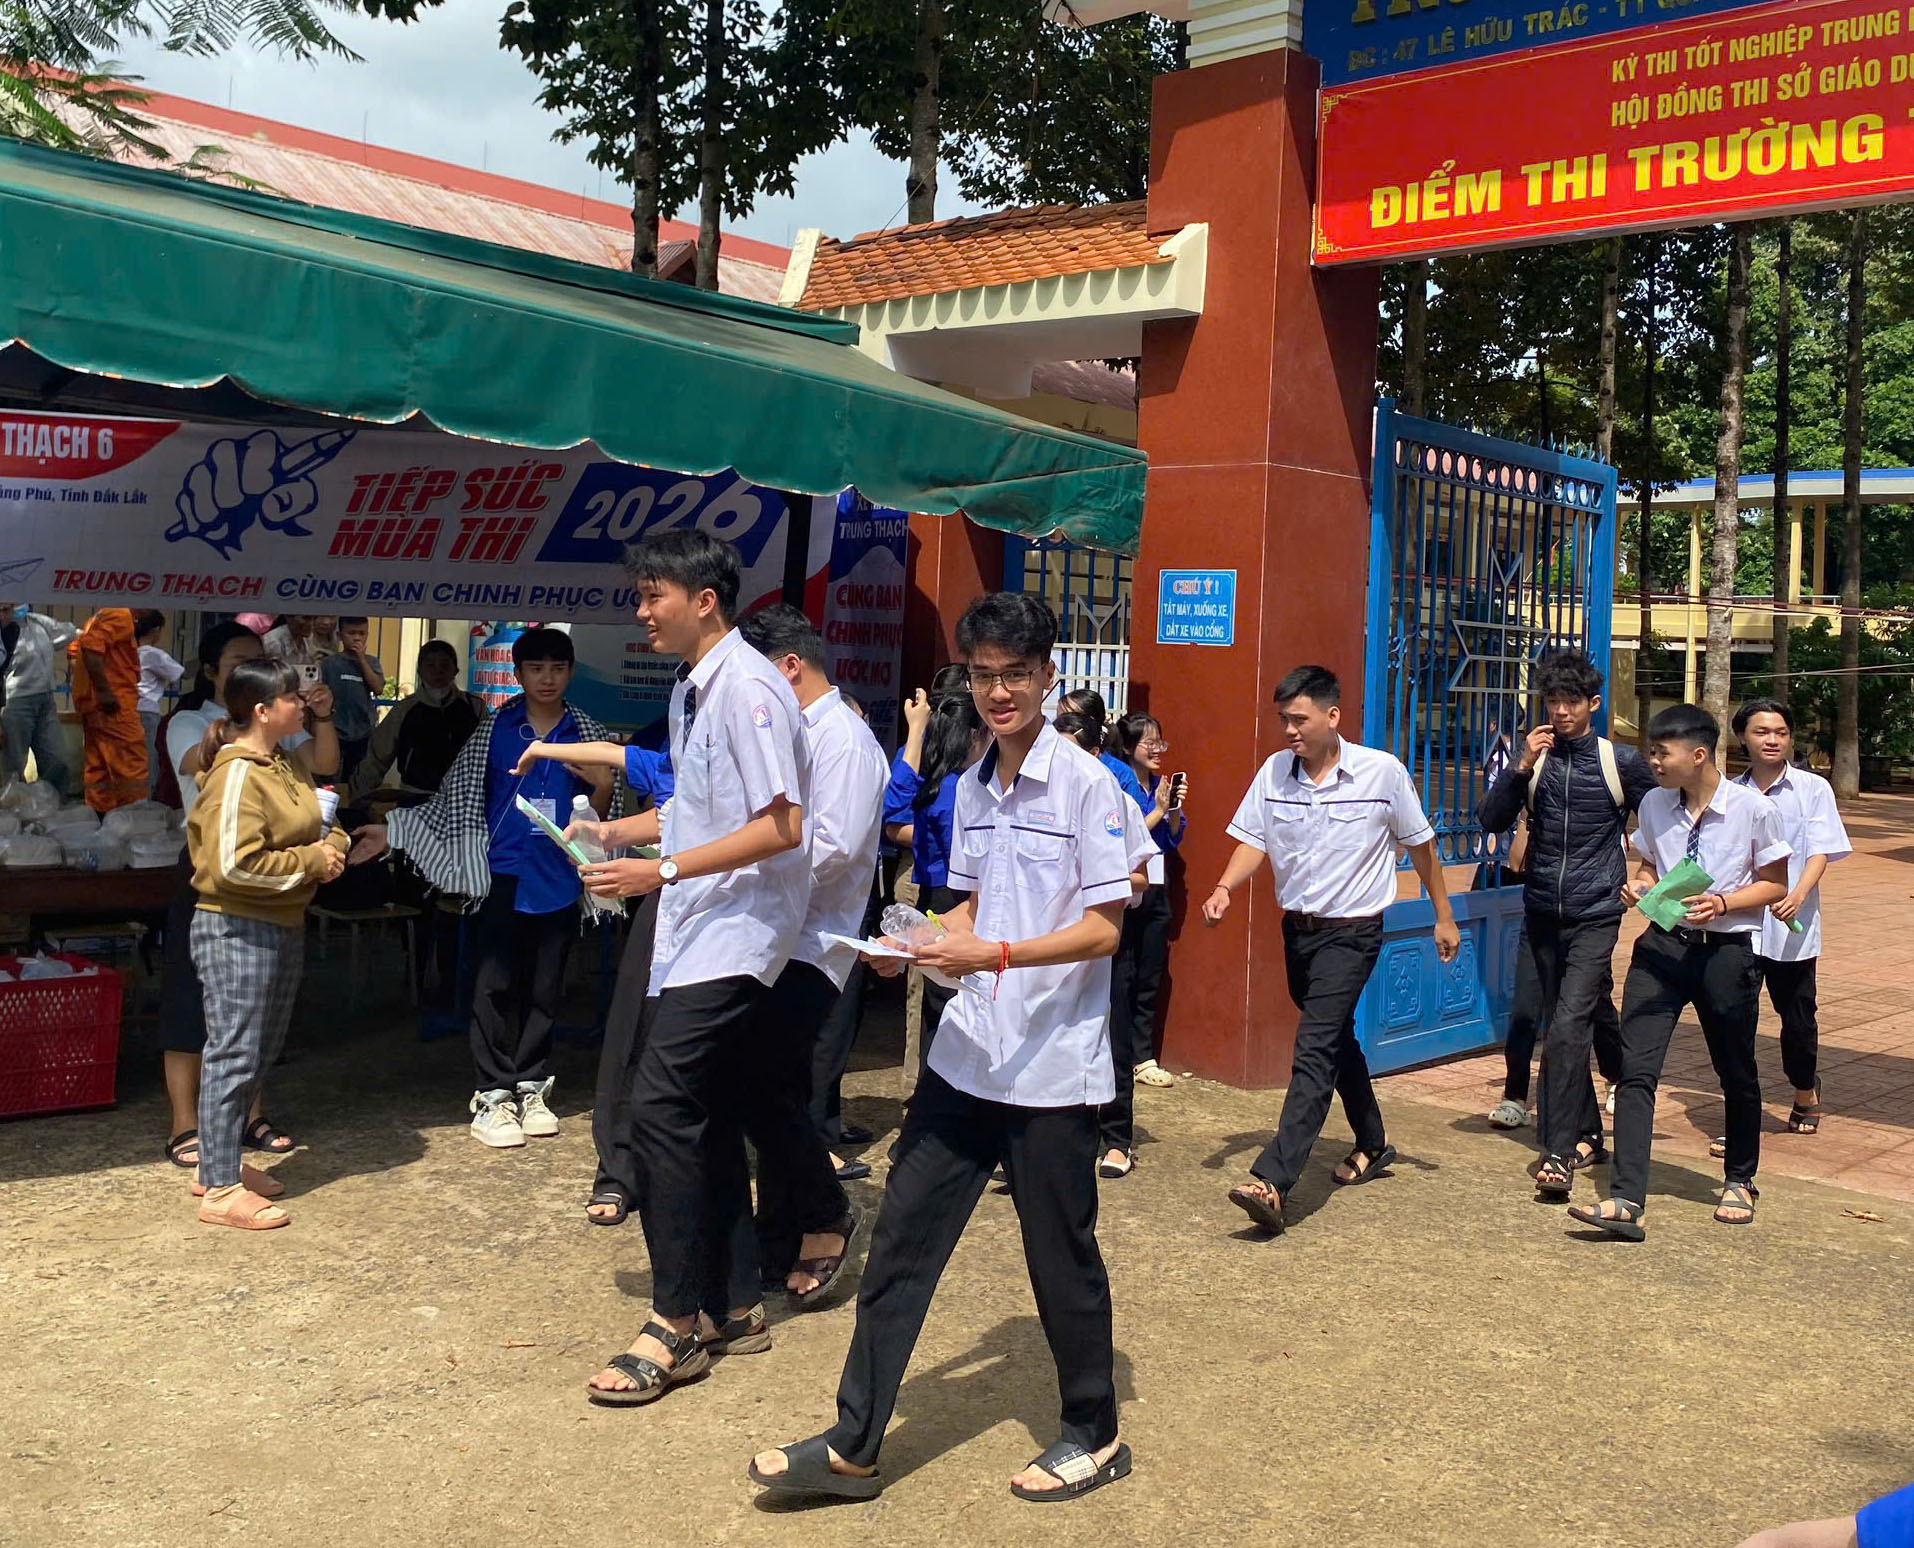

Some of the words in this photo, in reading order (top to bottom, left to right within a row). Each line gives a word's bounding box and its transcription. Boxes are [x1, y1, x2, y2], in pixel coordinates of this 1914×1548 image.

[1427, 26, 1455, 56] LÊ
[1465, 16, 1513, 48] HỮU
[1523, 0, 1589, 36] TRÁC
[1645, 49, 1678, 77] THI
[1684, 34, 1724, 70] TỐT
[1729, 23, 1814, 63] NGHIỆP
[1820, 9, 1901, 48] TRUNG
[1610, 93, 1650, 130] HỘI
[1656, 81, 1723, 120] ĐỒNG
[1730, 77, 1769, 108] THI
[1776, 61, 1812, 101] SỞ
[1818, 56, 1881, 94] GIÁO
[1368, 159, 1503, 229] ĐIỂM
[1521, 153, 1607, 207] THI
[1627, 113, 1885, 192] TRƯỜNG
[2, 421, 90, 465] THẠCH
[97, 427, 114, 461] 6
[345, 464, 461, 515] TIẾP
[459, 458, 567, 513] SỨC
[571, 478, 763, 541] 2026
[327, 513, 445, 561] MÙA
[447, 516, 538, 563] THI
[839, 521, 873, 540] TRUNG
[874, 518, 910, 544] THẠCH
[52, 569, 152, 593] TRUNG
[160, 573, 264, 604] THẠCH
[275, 573, 360, 600] CÙNG
[366, 581, 425, 607] BẠN
[432, 583, 523, 605] CHINH
[528, 585, 605, 612] PHỤC
[1194, 599, 1217, 616] XUỐNG
[826, 619, 871, 645] CHINH
[1180, 625, 1189, 637] XE
[1190, 621, 1204, 637] VÀO
